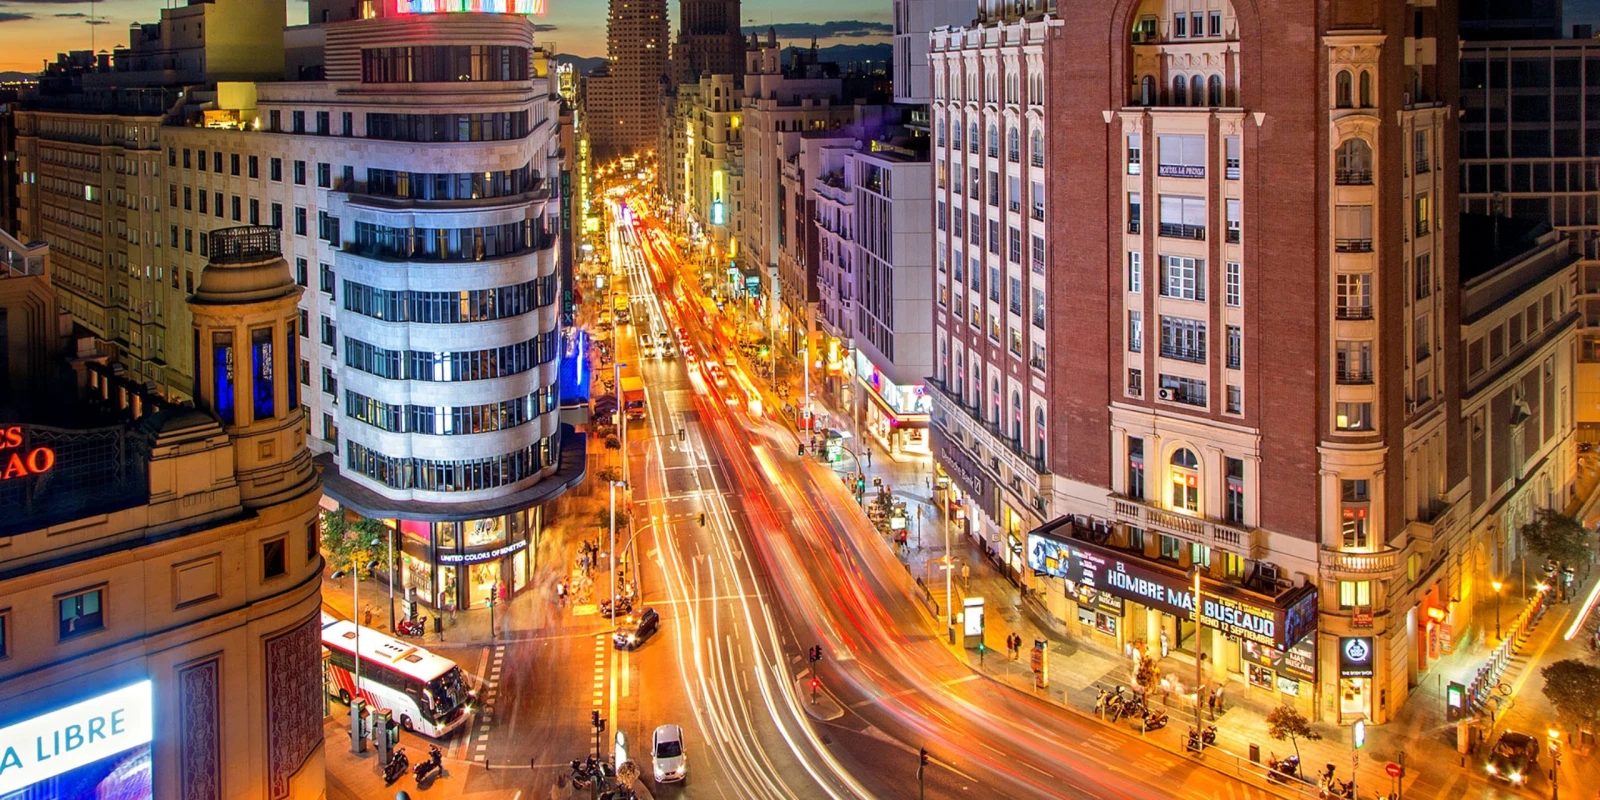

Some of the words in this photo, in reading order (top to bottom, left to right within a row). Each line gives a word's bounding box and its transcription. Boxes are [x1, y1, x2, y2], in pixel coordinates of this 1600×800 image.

[562, 174, 570, 230] HOTEL
[564, 290, 572, 322] REX
[440, 554, 464, 562] UNITED
[464, 551, 490, 561] COLORS
[491, 549, 500, 557] OF
[499, 539, 527, 555] BENETTON
[1116, 561, 1126, 573] EL
[1107, 570, 1165, 602] HOMBRE
[1204, 600, 1275, 638] BUSCADO
[1189, 611, 1220, 630] ESRENO
[1220, 621, 1229, 633] 12
[1230, 624, 1275, 647] SEPTIEMBRE
[36, 708, 125, 762] LIBRE
